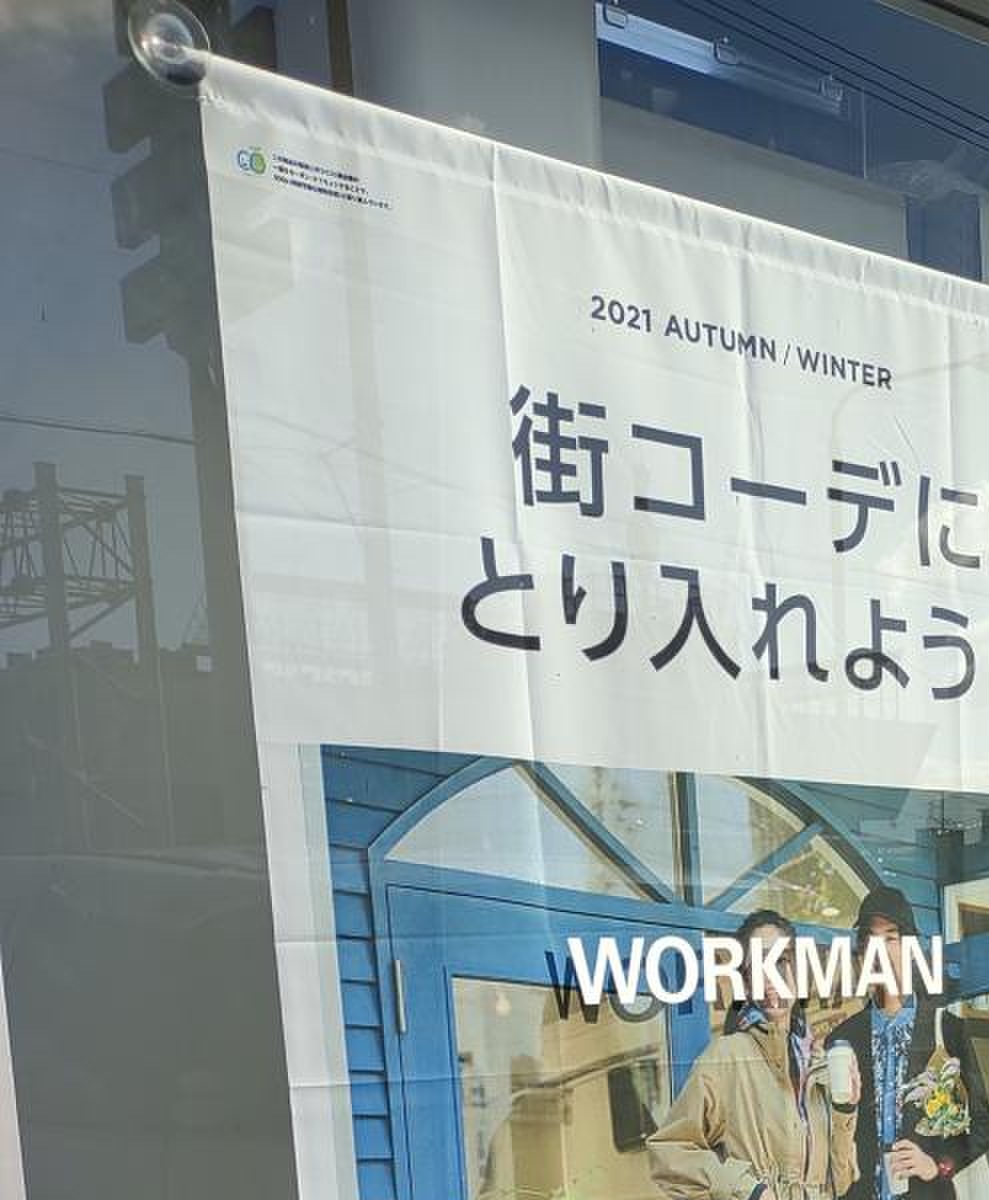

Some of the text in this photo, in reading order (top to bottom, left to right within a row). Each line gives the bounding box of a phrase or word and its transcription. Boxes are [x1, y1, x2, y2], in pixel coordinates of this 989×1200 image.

[591, 295, 652, 332] 2021
[664, 314, 777, 363] AUTUMN
[797, 346, 893, 390] WINTER
[509, 384, 982, 569] 街コーデに
[567, 934, 943, 1006] WORKMAN
